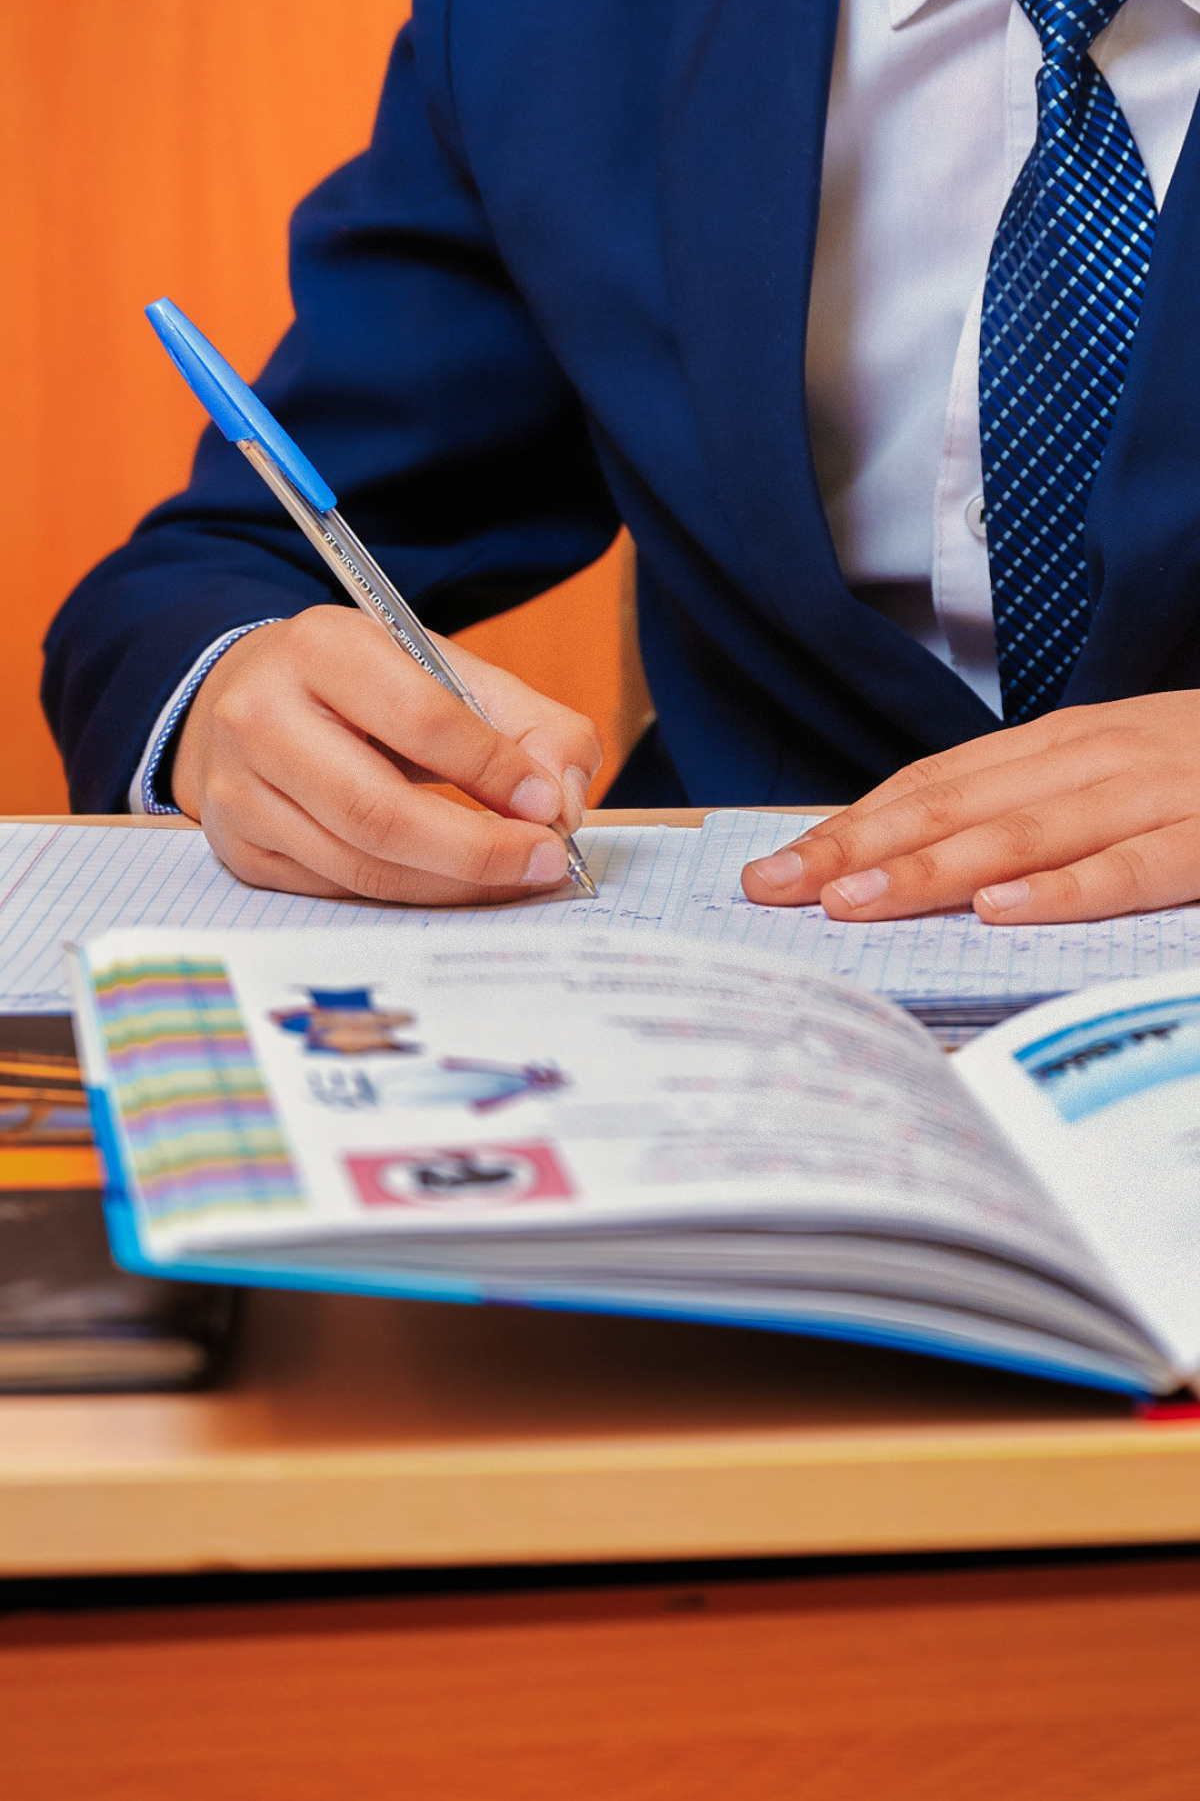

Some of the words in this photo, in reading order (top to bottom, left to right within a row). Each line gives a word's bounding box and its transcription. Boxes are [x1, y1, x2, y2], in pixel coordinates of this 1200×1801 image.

[324, 532, 337, 548] 1.0
[337, 549, 370, 591] CLASSIC
[369, 592, 395, 625] R-301
